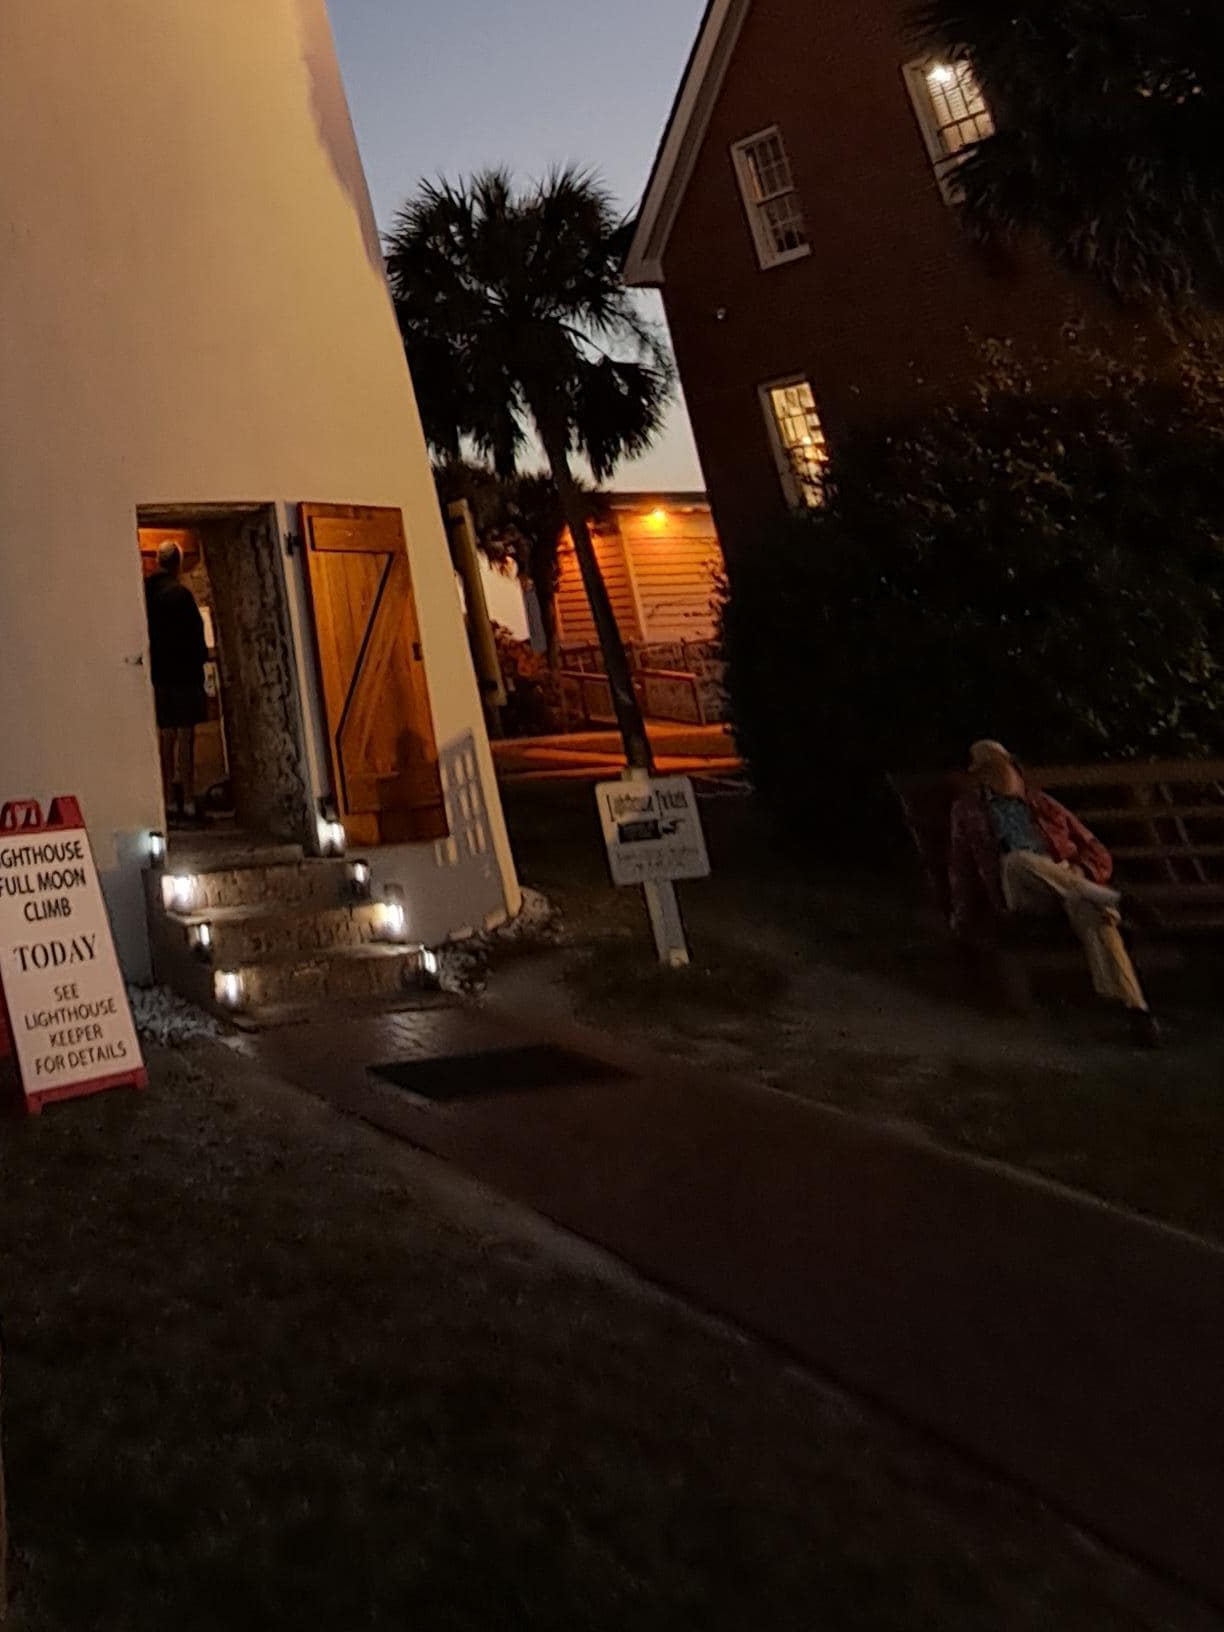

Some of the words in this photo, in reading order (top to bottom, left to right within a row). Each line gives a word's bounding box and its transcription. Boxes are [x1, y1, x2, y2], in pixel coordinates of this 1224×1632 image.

[37, 867, 86, 891] MOON
[24, 897, 71, 922] CLIMB
[12, 933, 96, 972] TODAY
[54, 983, 79, 1002] SEE
[24, 998, 117, 1031] LIGHTHOUSE
[49, 1023, 103, 1048] KEEPER
[35, 1054, 66, 1075] FOR
[67, 1040, 127, 1068] DETAILS
